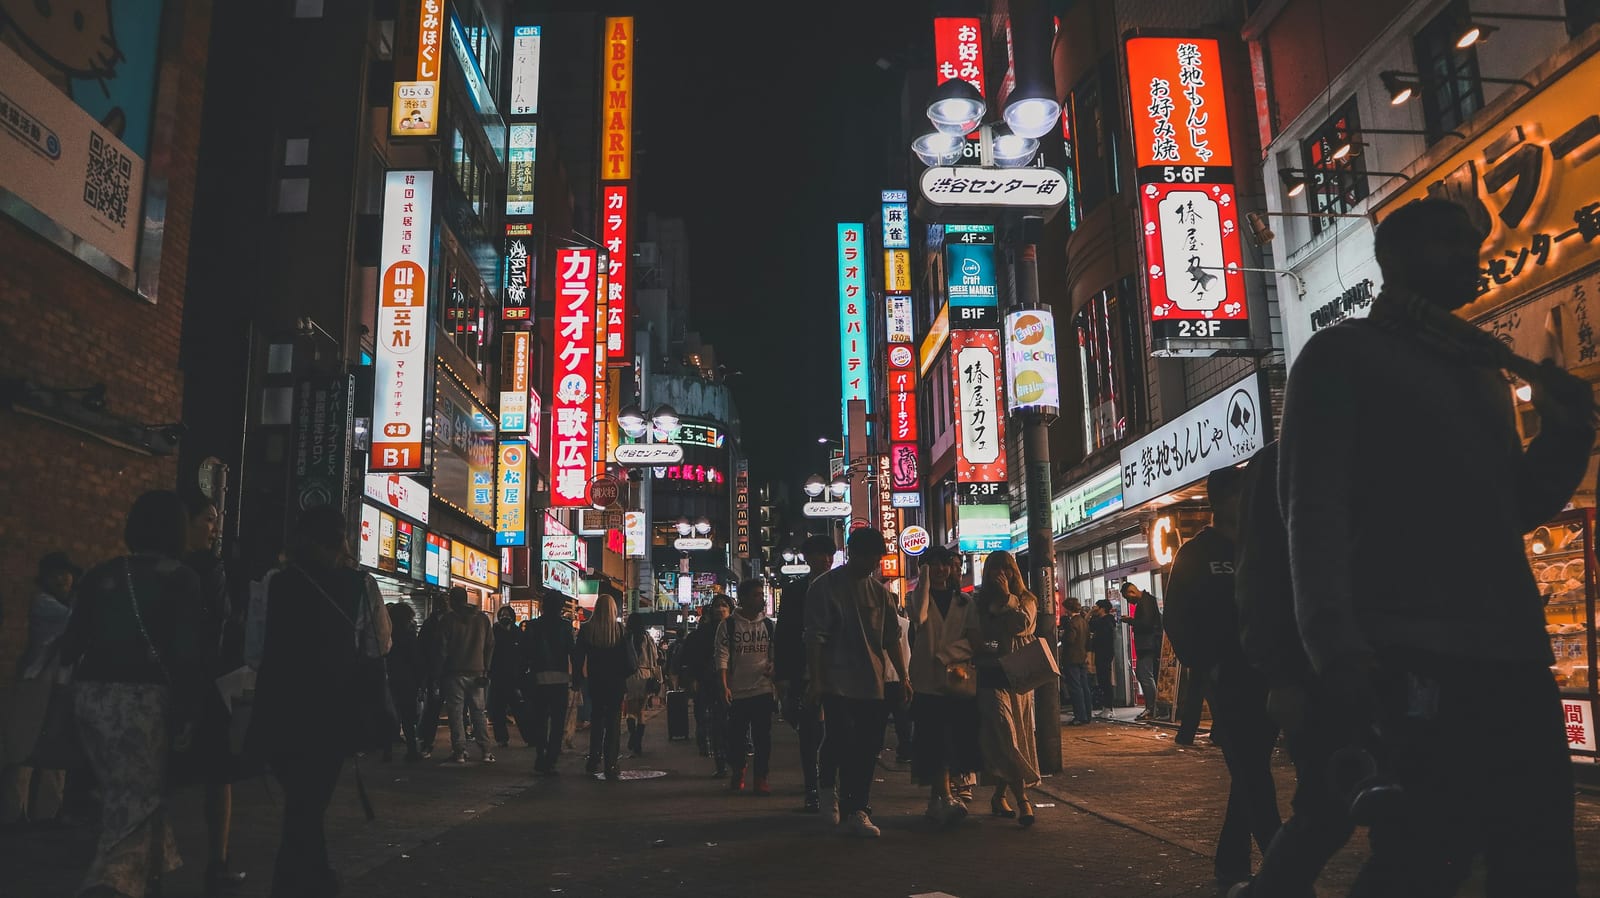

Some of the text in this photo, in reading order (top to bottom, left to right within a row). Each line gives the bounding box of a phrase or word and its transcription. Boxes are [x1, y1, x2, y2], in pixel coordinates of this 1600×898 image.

[517, 28, 538, 36] CBR
[401, 88, 431, 96] りらくる
[403, 100, 427, 108] 渋谷店
[517, 106, 531, 114] 5F
[1177, 44, 1213, 161] 築地もんじゃ
[1149, 77, 1180, 161] お好み焼
[930, 178, 1060, 195] 渋谷センター街
[401, 175, 415, 255] 韓国式居酒屋
[889, 210, 902, 240] 麻雀
[961, 233, 977, 243] 4F
[607, 193, 623, 351] カラオケ歌広場
[962, 275, 980, 285] Craft
[969, 286, 994, 295] MARKET
[392, 267, 414, 347] 마약포차
[507, 310, 527, 318] 3F
[962, 308, 985, 319] B1F
[1015, 322, 1042, 341] Enjoy
[557, 251, 590, 499] カラオケ 歌広場
[897, 375, 909, 438] バーガーキング
[965, 360, 989, 450] 椿屋カフェ
[505, 416, 521, 427] 2F
[383, 448, 409, 466] B1
[1125, 419, 1223, 488] 5F 築地もんじゃ
[504, 469, 521, 503] 松屋
[903, 532, 925, 542] BURGER
[904, 537, 926, 548] KING
[884, 559, 897, 570] B1
